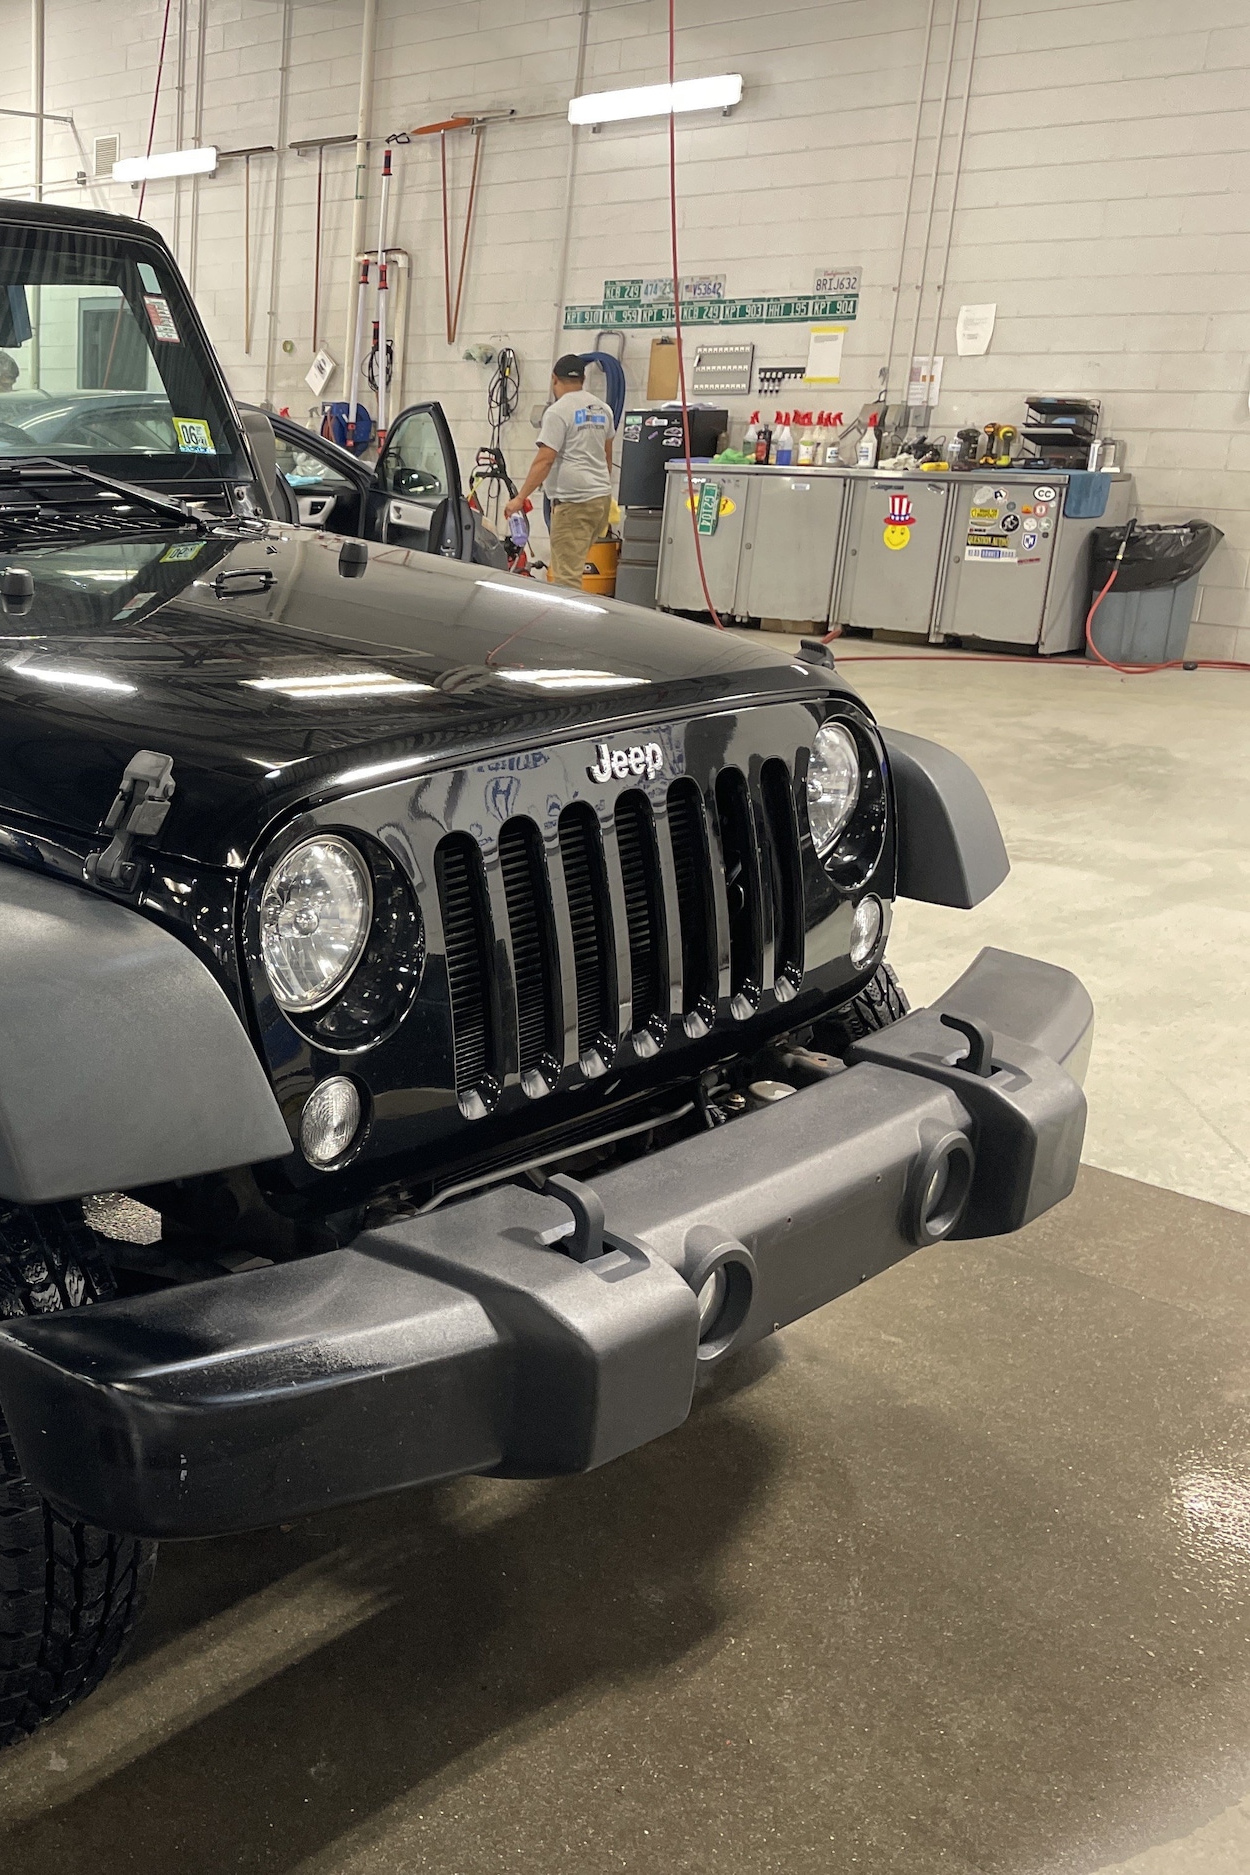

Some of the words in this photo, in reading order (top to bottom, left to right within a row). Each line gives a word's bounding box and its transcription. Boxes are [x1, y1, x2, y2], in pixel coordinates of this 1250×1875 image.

[605, 286, 621, 299] KCB
[623, 285, 640, 298] 249
[682, 306, 698, 320] KCB
[703, 305, 720, 319] 249
[724, 304, 741, 318] KPT
[746, 303, 762, 317] 903
[768, 303, 786, 317] HHT
[790, 302, 807, 316] 195
[814, 302, 831, 315] KPT
[836, 300, 854, 314] 904
[566, 310, 581, 324] KPT
[584, 309, 599, 323] 910
[622, 309, 638, 322] 959
[642, 309, 657, 322] KPT
[181, 424, 198, 445] 06
[1037, 489, 1052, 498] CC
[587, 742, 664, 784] Jeep
